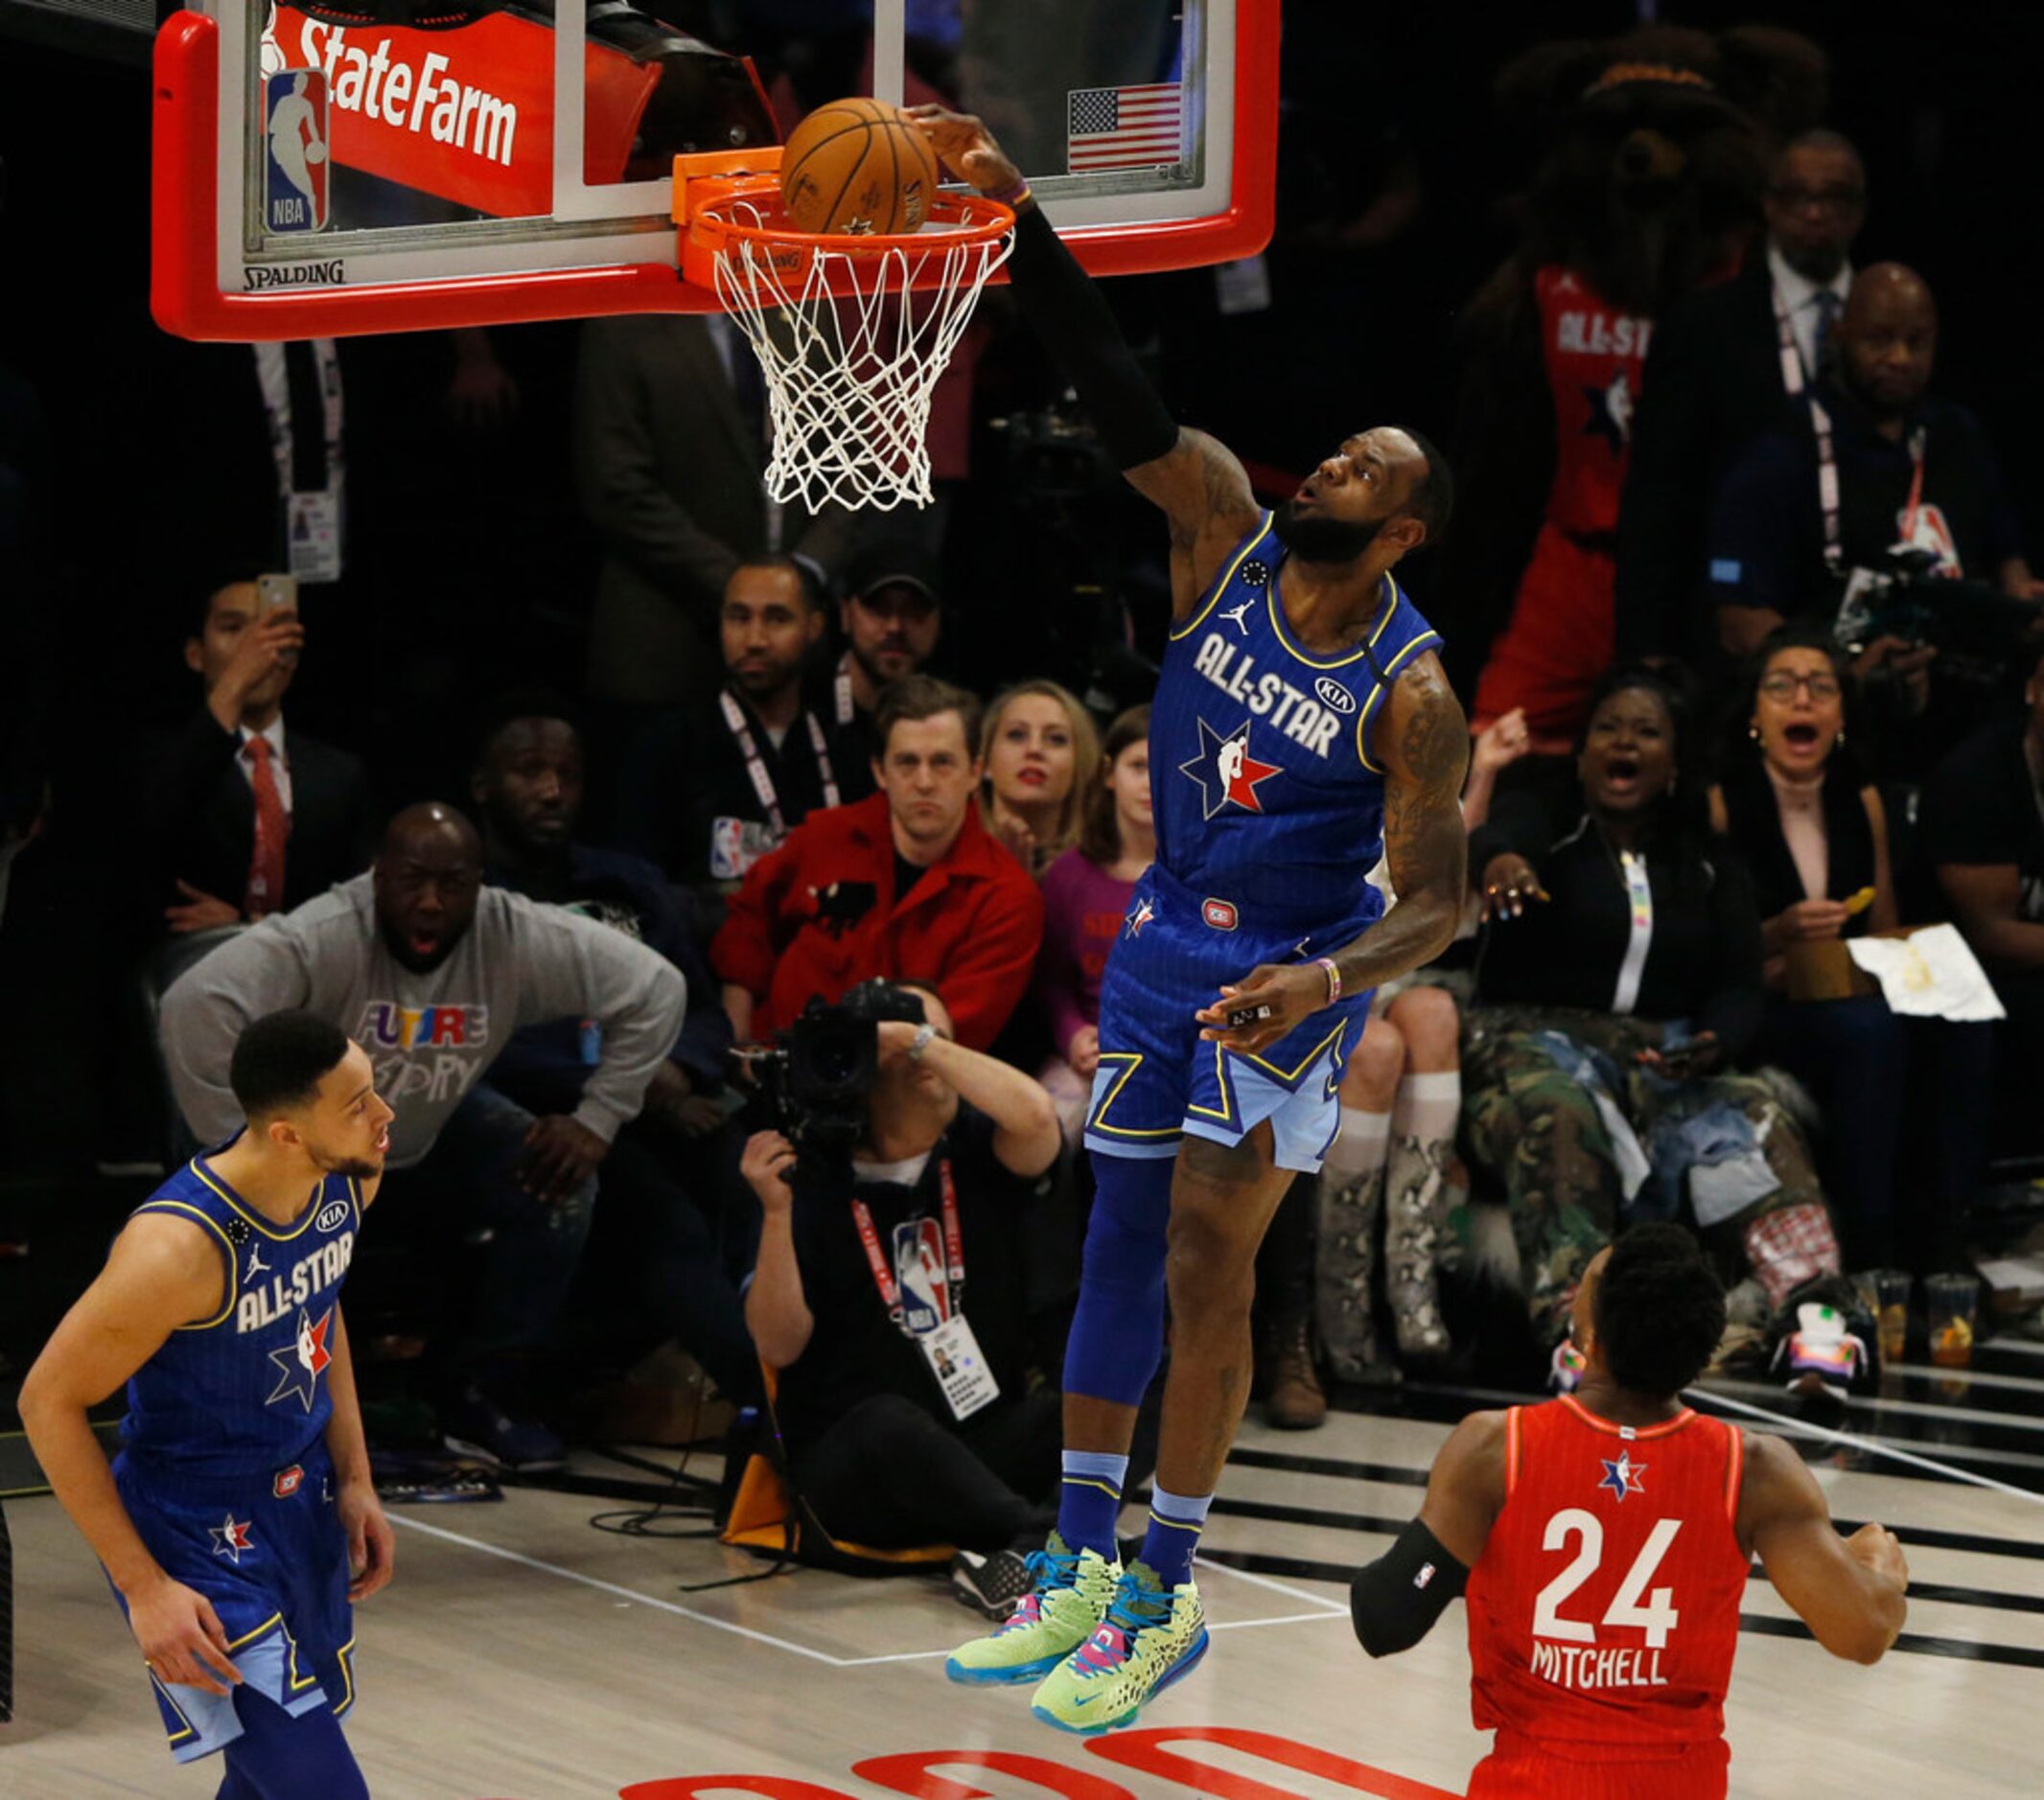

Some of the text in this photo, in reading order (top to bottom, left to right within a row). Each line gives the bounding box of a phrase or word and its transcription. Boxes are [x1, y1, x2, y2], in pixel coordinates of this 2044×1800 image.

[272, 197, 305, 226] NBA
[244, 260, 345, 290] SPALDING
[1193, 633, 1341, 759] ALL-STAR
[1319, 680, 1350, 710] KIA
[356, 1000, 489, 1052] FUTURE
[319, 1205, 345, 1230] KIA
[237, 1231, 354, 1333] ALL-STAR
[1532, 1508, 1683, 1649] 24
[1530, 1640, 1668, 1690] MITCHELL
